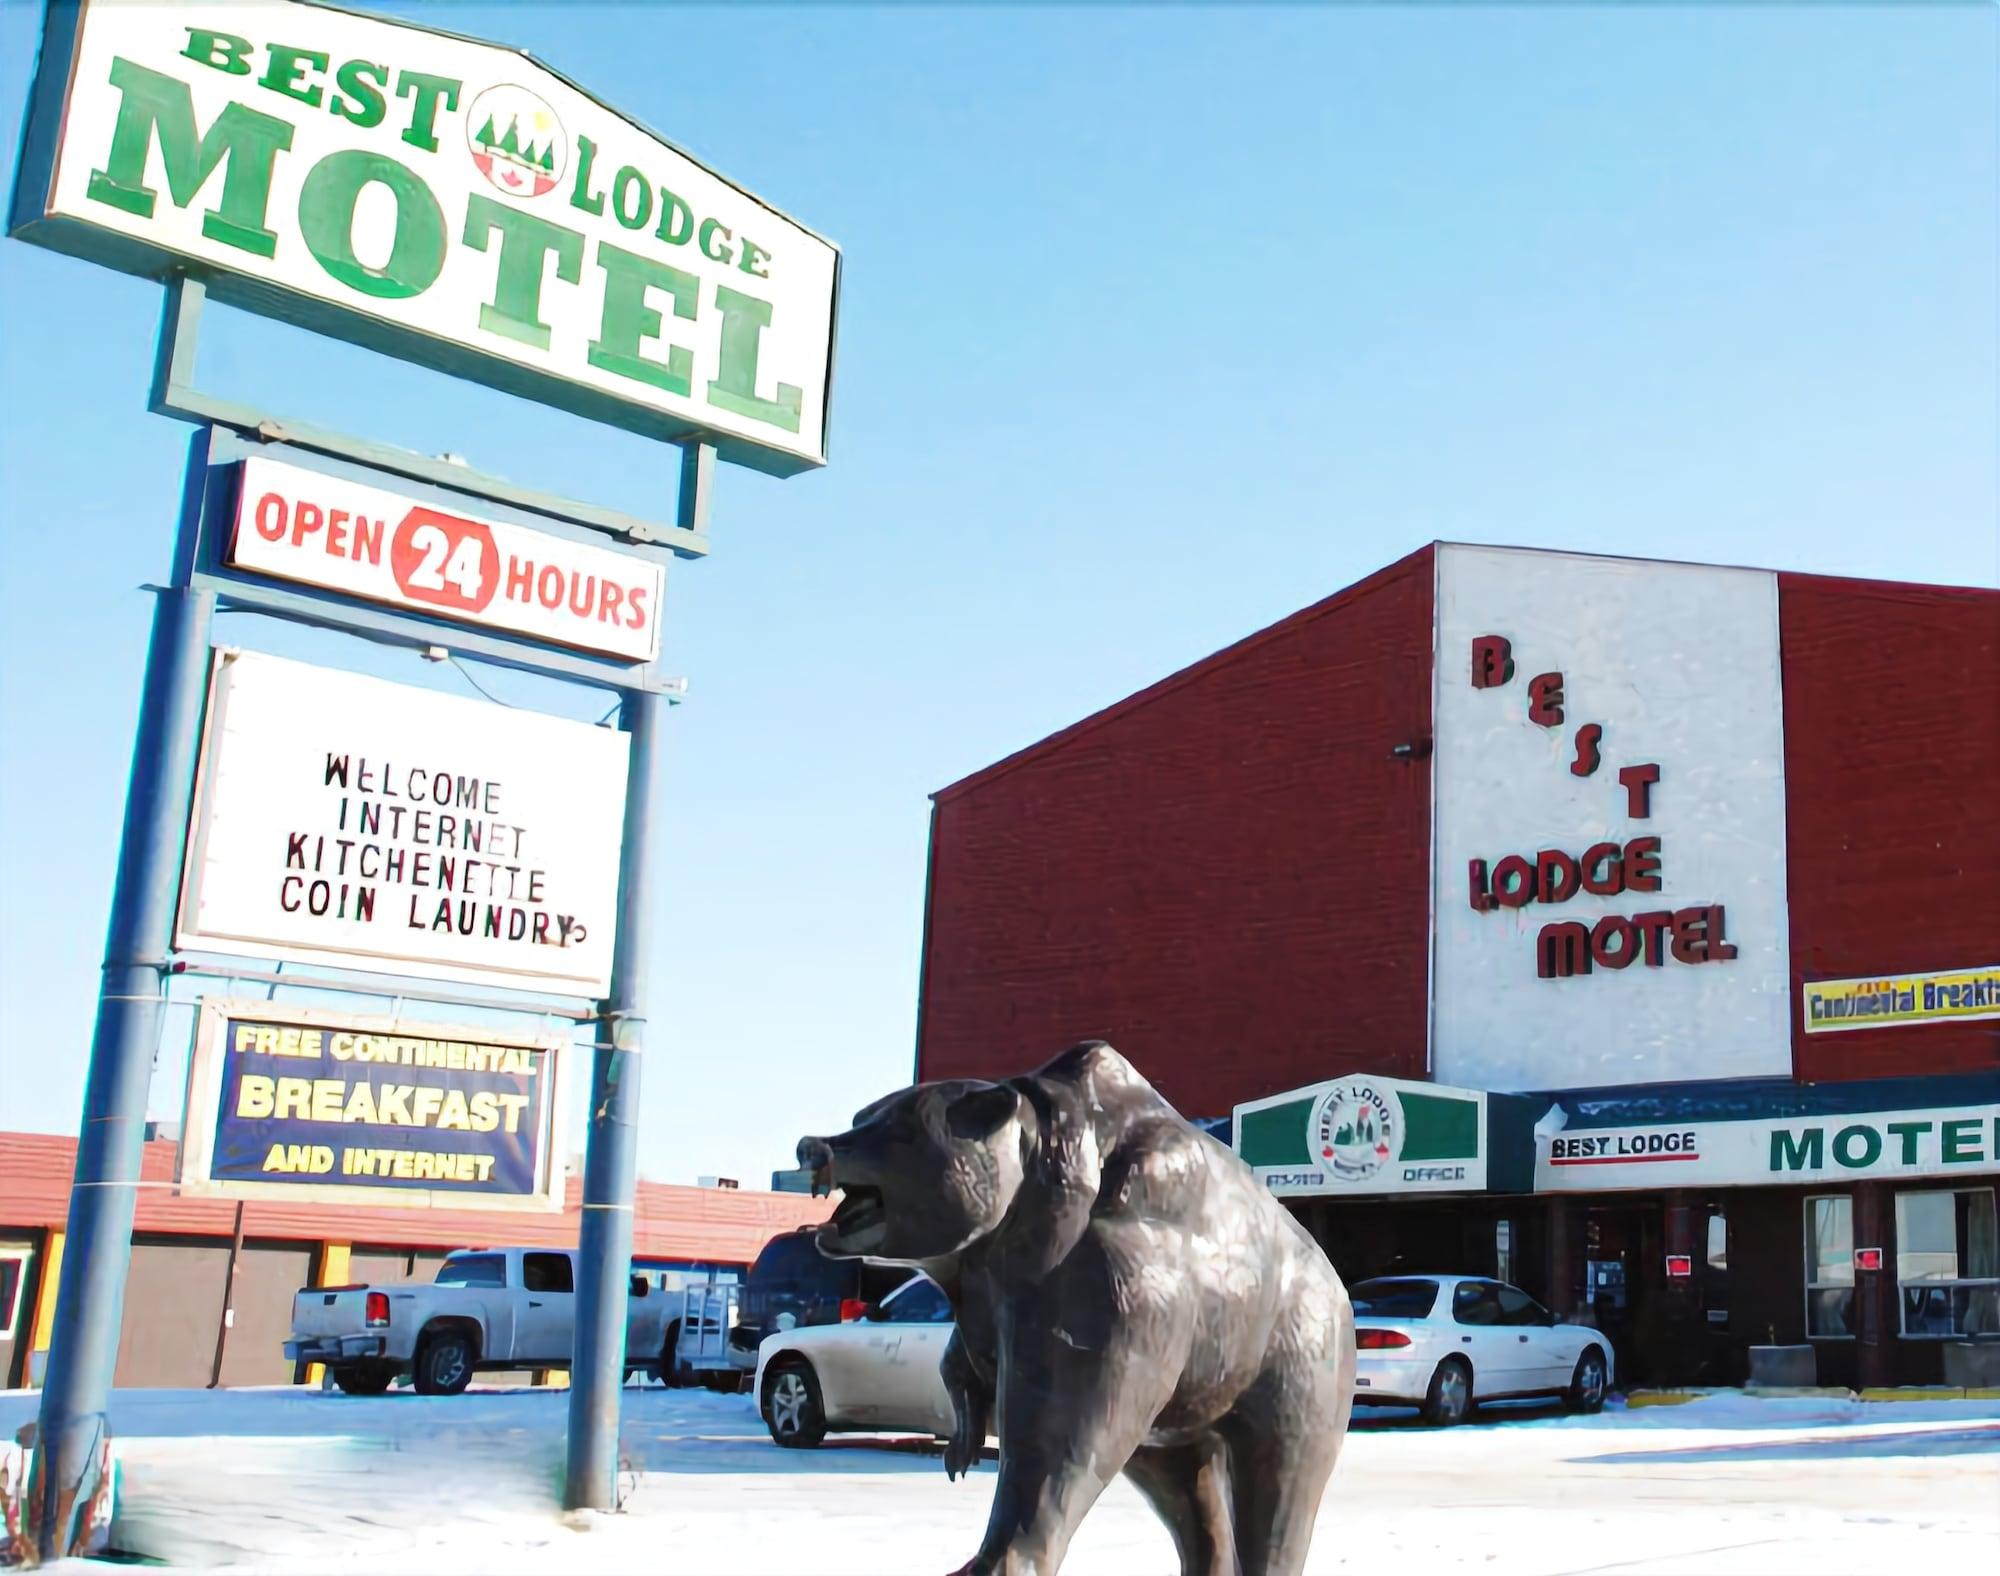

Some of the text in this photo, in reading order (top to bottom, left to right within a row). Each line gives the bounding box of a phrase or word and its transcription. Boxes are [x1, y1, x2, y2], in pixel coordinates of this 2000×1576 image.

[180, 27, 771, 279] BEST LODGE
[87, 56, 803, 433] MOTEL
[255, 492, 648, 630] OPEN 24 HOURS
[324, 752, 502, 815] WELCOME
[338, 797, 527, 859] INTERNET
[285, 831, 546, 903] KITCHENETTE
[1469, 837, 1661, 912] LODGE
[280, 876, 377, 922] COIN
[1537, 905, 1737, 979] MOTEL
[235, 1025, 537, 1076] FREE CONTINENTAL
[236, 1074, 530, 1134] BREAKFAST
[261, 1143, 496, 1182] AND INTERNET
[1551, 1132, 1696, 1158] BEST LODGE
[1770, 1117, 2000, 1170] MOTE
